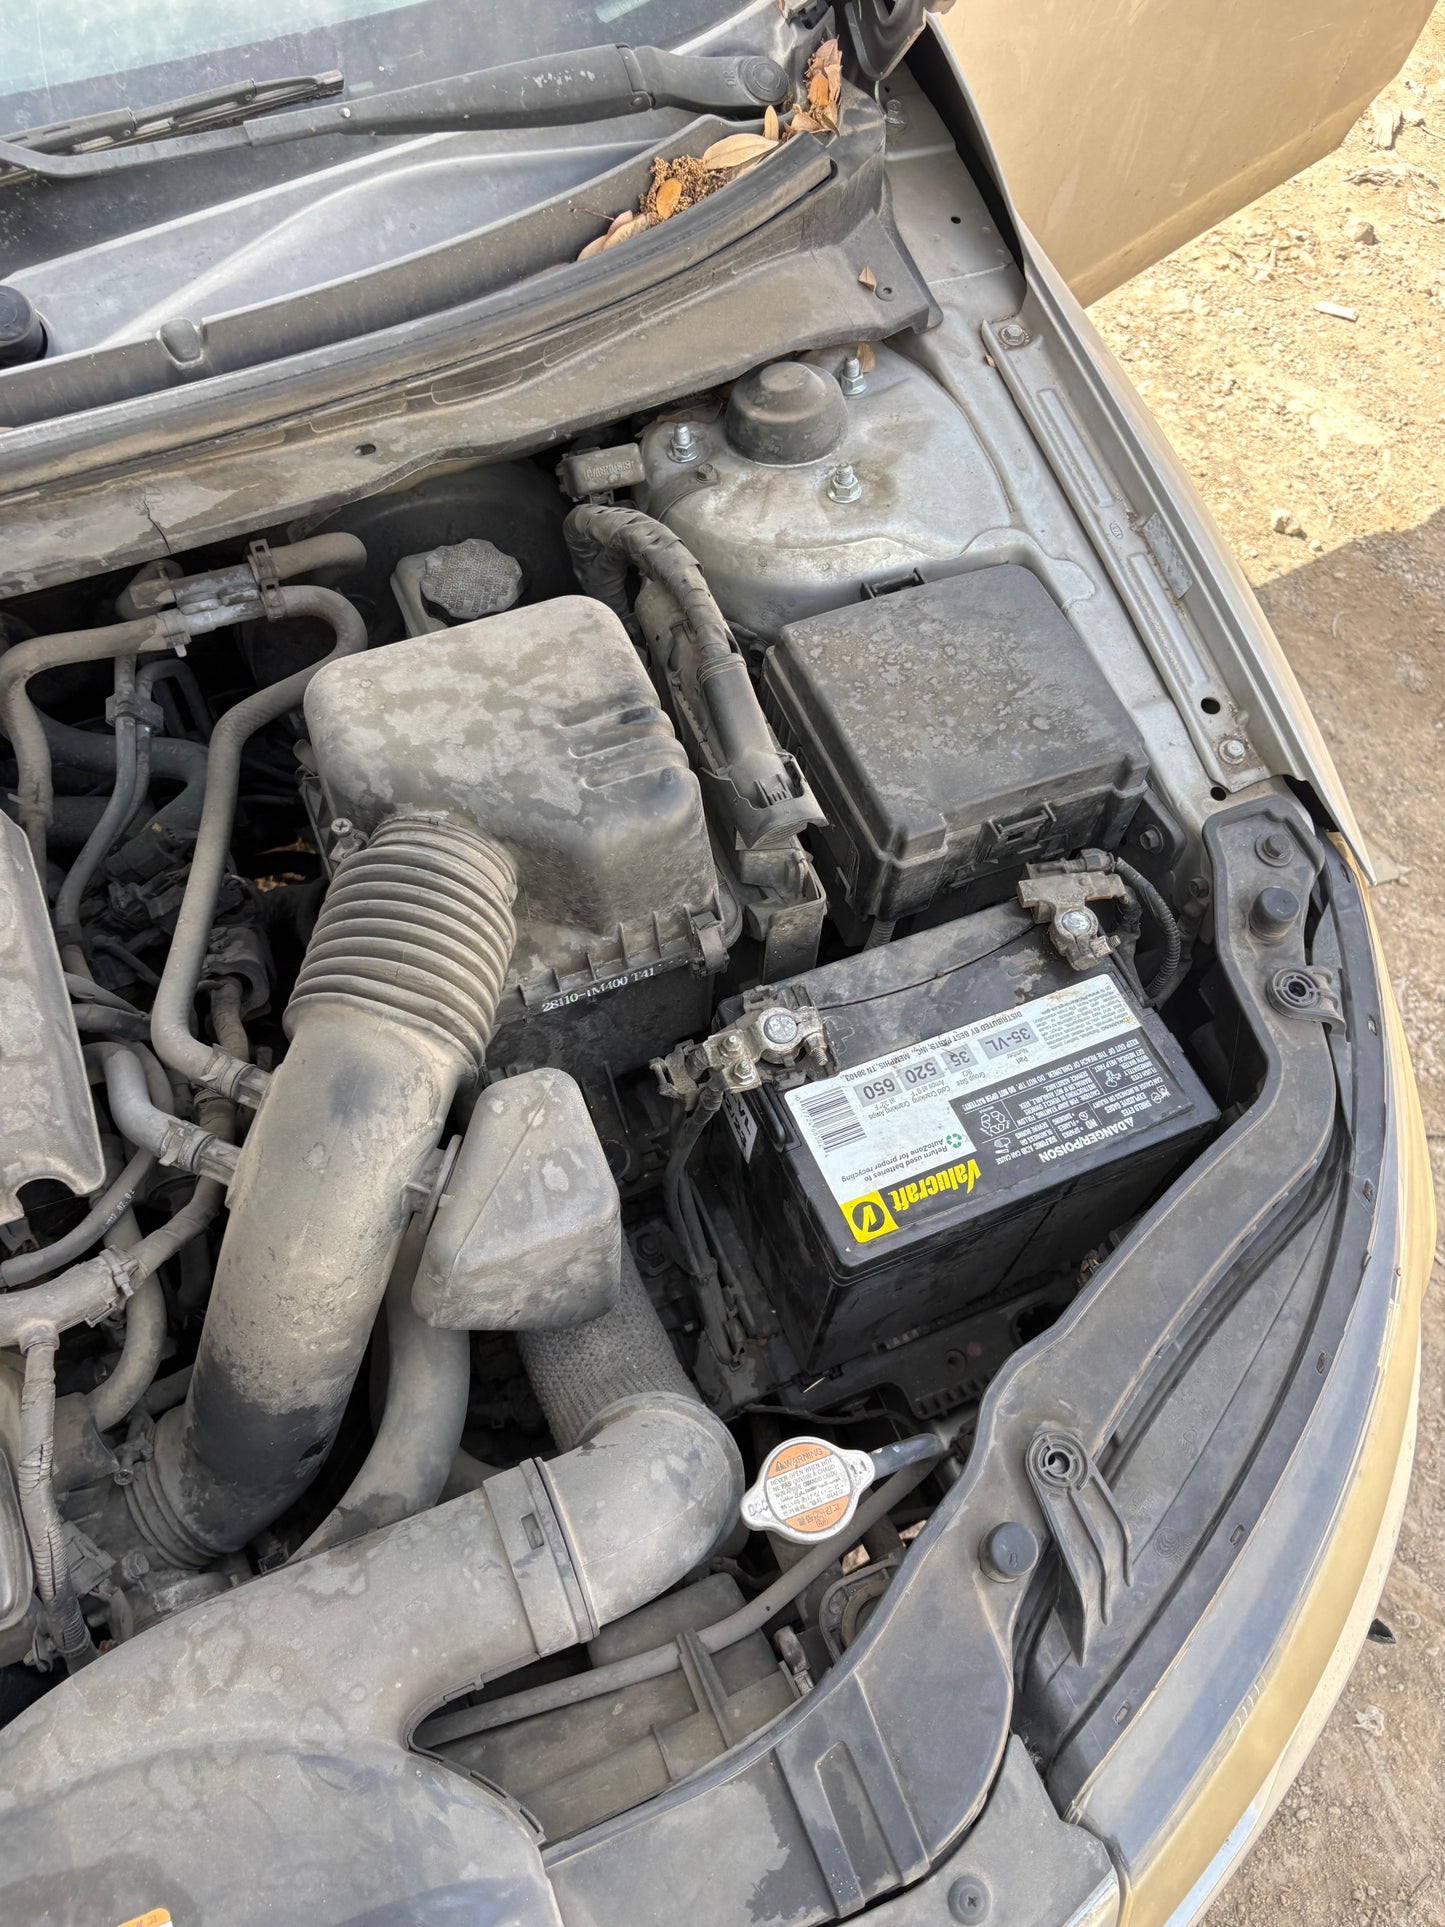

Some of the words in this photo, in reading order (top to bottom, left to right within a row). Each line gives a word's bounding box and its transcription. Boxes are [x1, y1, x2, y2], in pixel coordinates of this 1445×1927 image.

[979, 1010, 1022, 1031] DISTRIBUTED
[951, 1030, 970, 1041] BEST
[969, 1026, 980, 1035] BY
[984, 1027, 1031, 1053] 35-VL
[948, 1050, 971, 1067] 35
[1015, 1055, 1028, 1064] Part
[865, 1064, 876, 1073] TN
[903, 1061, 938, 1084] 520
[861, 1077, 896, 1100] 650
[1084, 1118, 1097, 1129] NO
[909, 1138, 945, 1156] AutoZone
[1037, 1119, 1127, 1163] DANGER/POISON
[897, 1152, 909, 1160] for
[922, 1144, 948, 1159] Return
[873, 1155, 898, 1169] proper
[904, 1155, 923, 1166] used
[840, 1164, 875, 1183] recycling
[863, 1175, 872, 1183] to
[872, 1162, 904, 1179] batteries
[889, 1158, 982, 1212] Valucraft
[783, 1447, 824, 1468] WARNING
